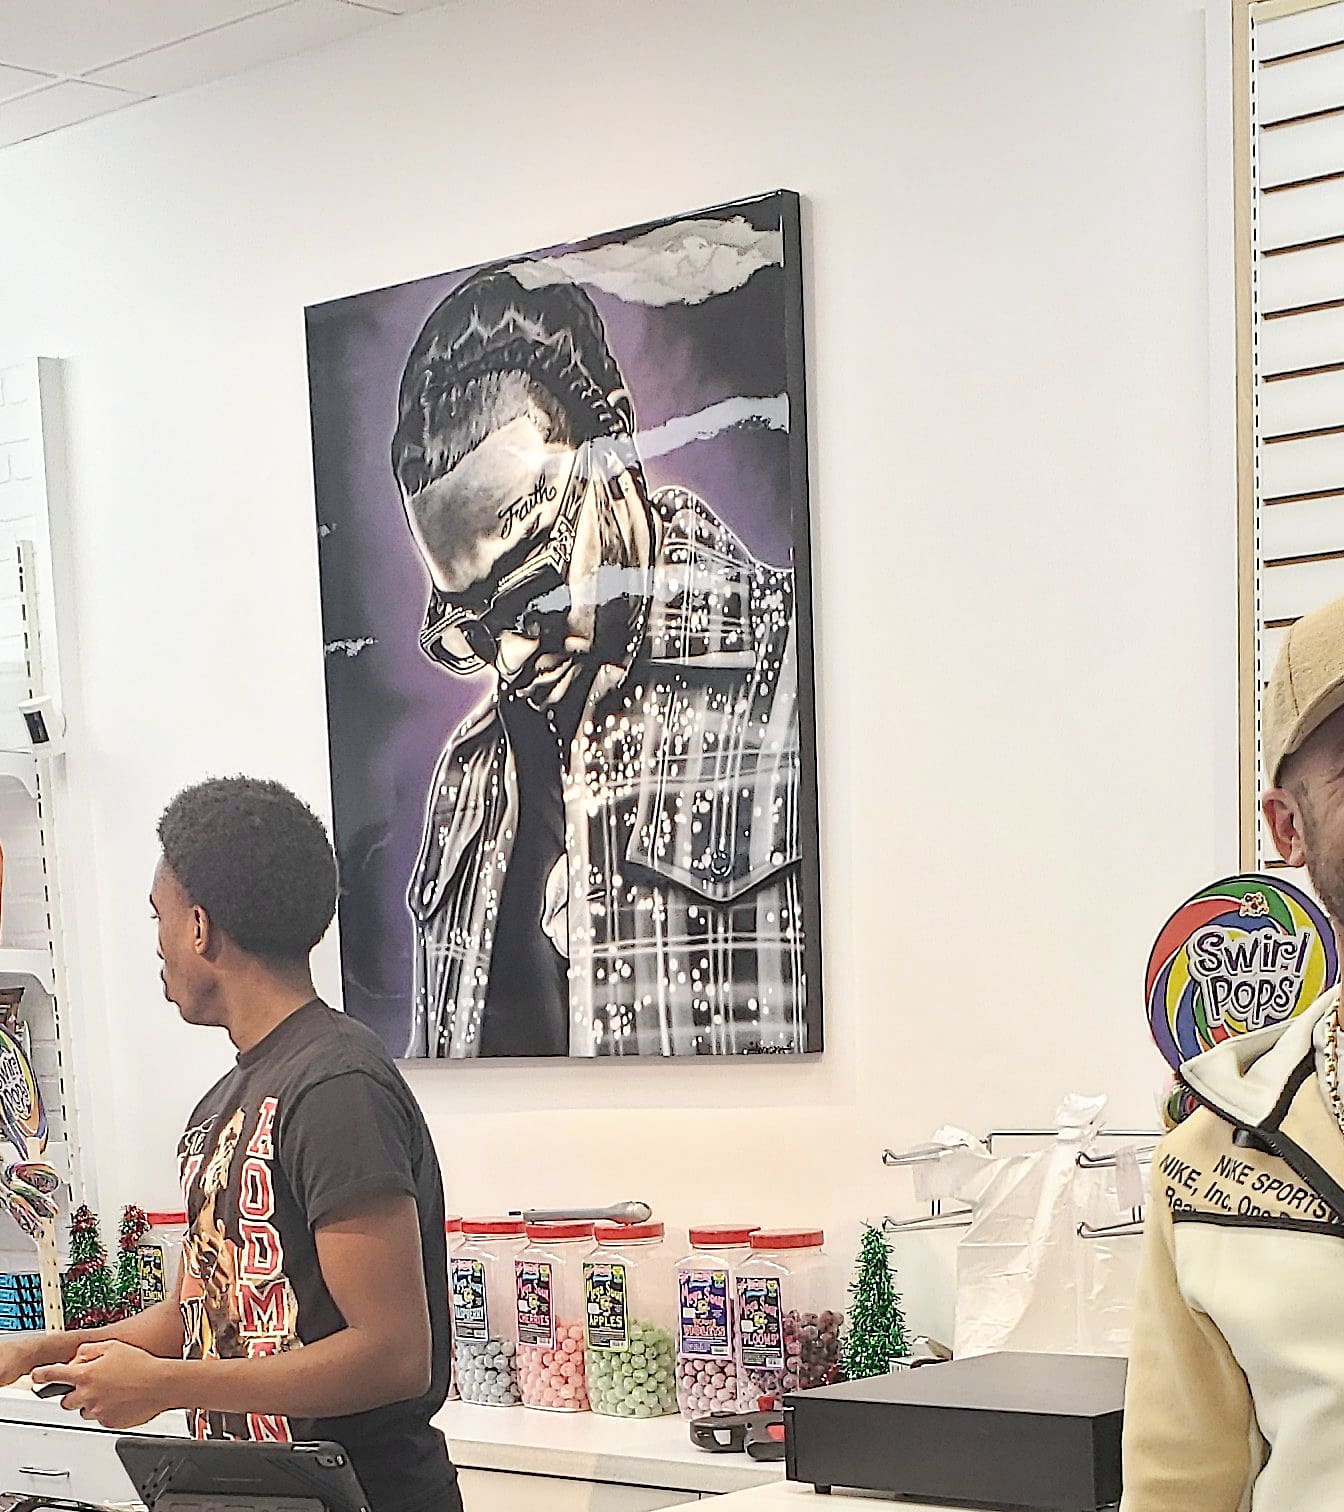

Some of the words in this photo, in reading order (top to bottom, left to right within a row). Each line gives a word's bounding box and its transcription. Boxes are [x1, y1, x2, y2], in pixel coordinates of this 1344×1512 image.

[498, 473, 557, 540] Faith
[1196, 931, 1311, 975] Swirl
[1208, 975, 1295, 1026] Pops
[1159, 1154, 1201, 1196] NIKE,
[1213, 1154, 1254, 1185] NIKE
[589, 1315, 623, 1327] APPLES
